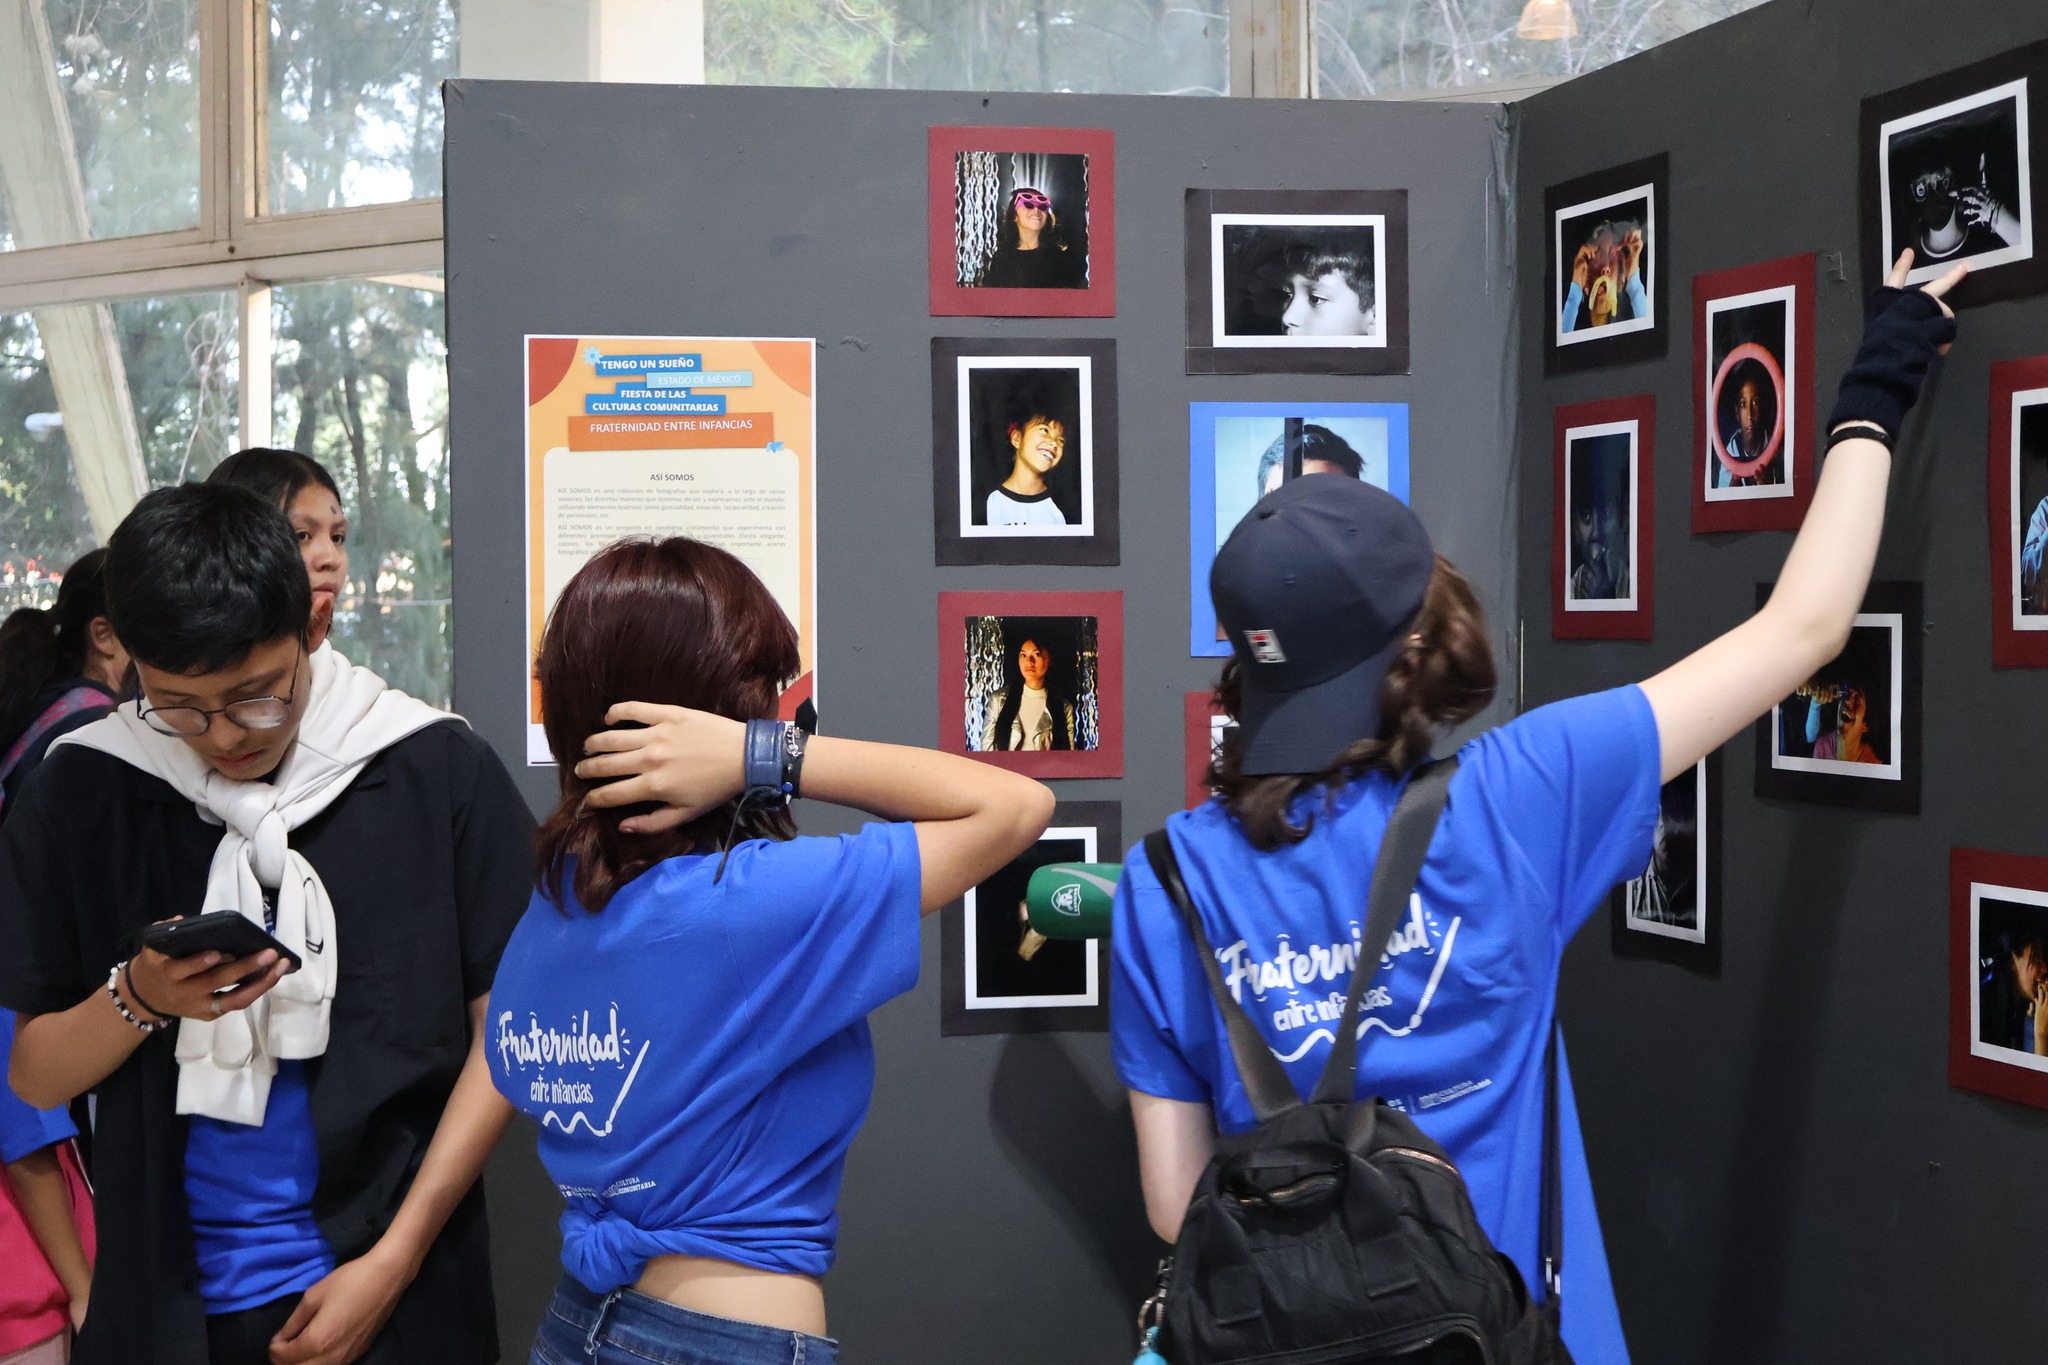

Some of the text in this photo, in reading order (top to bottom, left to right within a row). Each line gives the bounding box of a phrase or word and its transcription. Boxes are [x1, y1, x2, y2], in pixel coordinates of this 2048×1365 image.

[601, 357, 694, 370] TENGO UN SUEÑO
[658, 373, 741, 385] ESTADO DE MÉXICO
[621, 390, 686, 399] FIESTA DE LAS
[592, 402, 719, 412] CULTURAS COMUNITARIAS
[590, 419, 753, 433] FRATERNIDAD ENTRE INFANCIAS
[650, 472, 695, 481] ASÍ SOMOS
[1222, 892, 1429, 1006] Fraterniad
[1273, 998, 1317, 1031] entre
[499, 1008, 621, 1072] Fraternidad
[530, 1074, 594, 1104] entre infancias
[615, 1176, 640, 1187] CULTURA
[618, 1180, 656, 1194] COMUNITARIA
